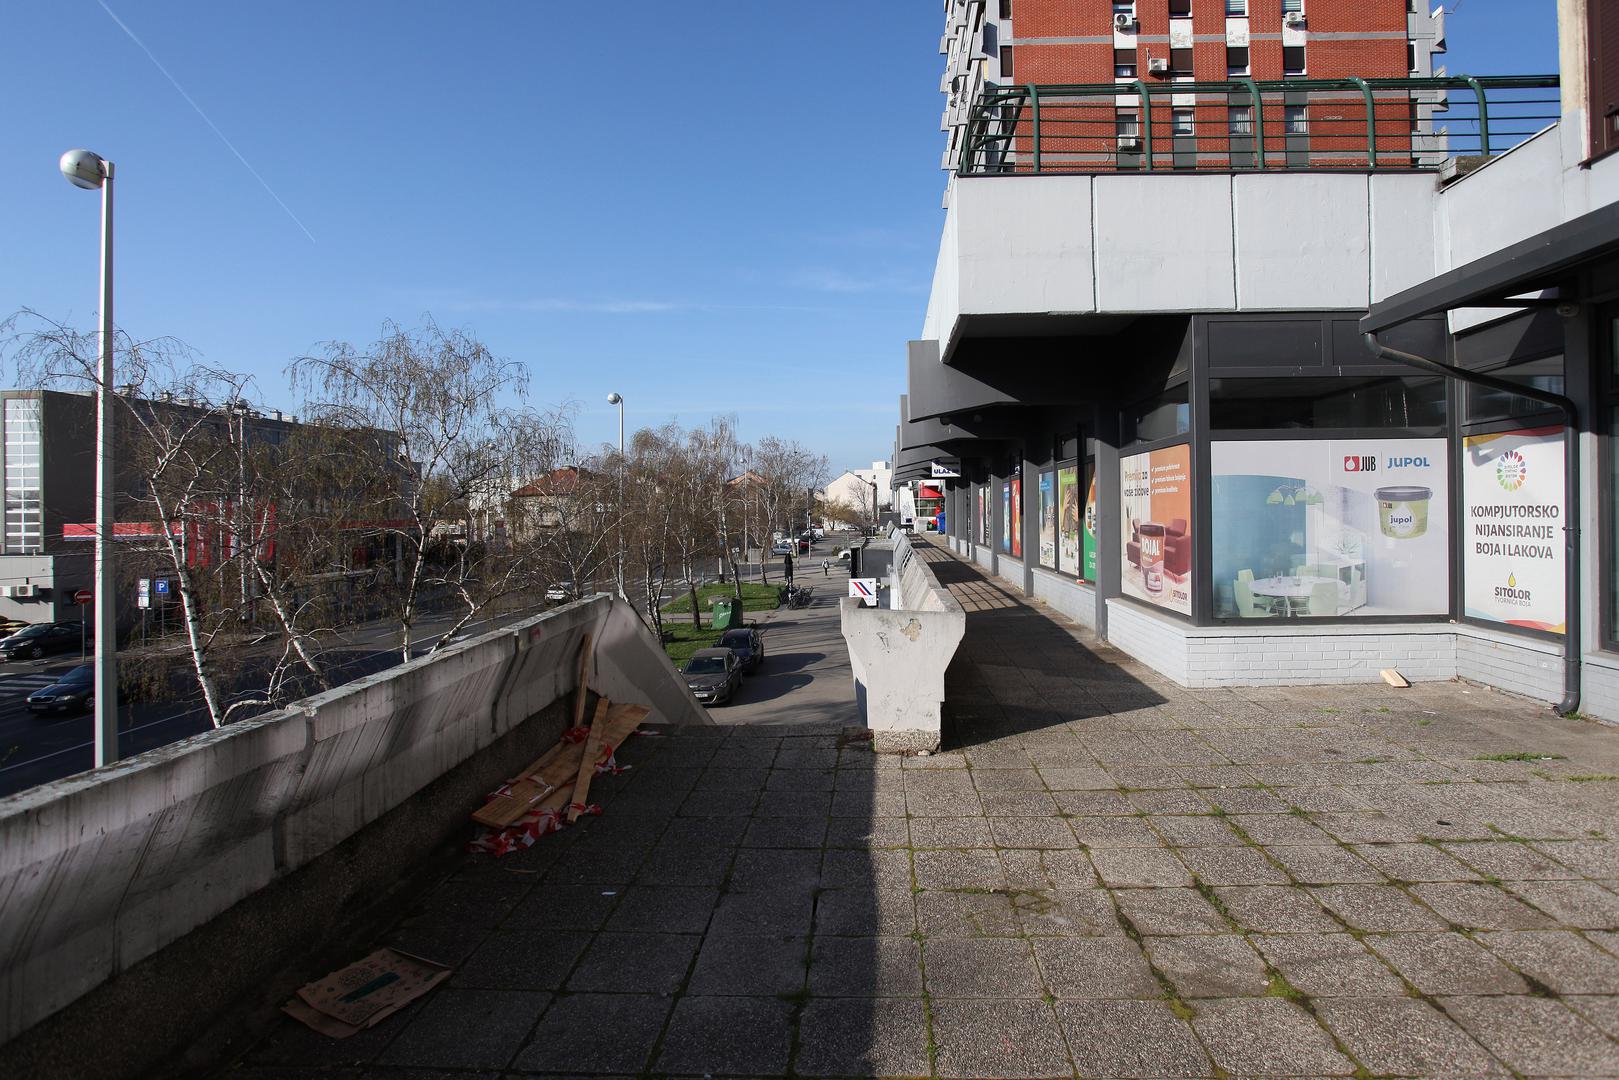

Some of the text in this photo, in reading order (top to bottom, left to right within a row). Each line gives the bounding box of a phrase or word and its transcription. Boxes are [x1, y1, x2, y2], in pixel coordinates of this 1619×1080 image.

[1361, 456, 1376, 471] JUB
[1387, 457, 1430, 469] JUPOL
[1470, 505, 1559, 519] KOMPJUTORSKO
[1390, 515, 1412, 524] jupol
[1475, 524, 1554, 540] NIJANSIRANJE
[1476, 542, 1554, 559] BOJA I LAKOVA
[158, 583, 165, 592] P
[1494, 586, 1531, 600] SITOLOR
